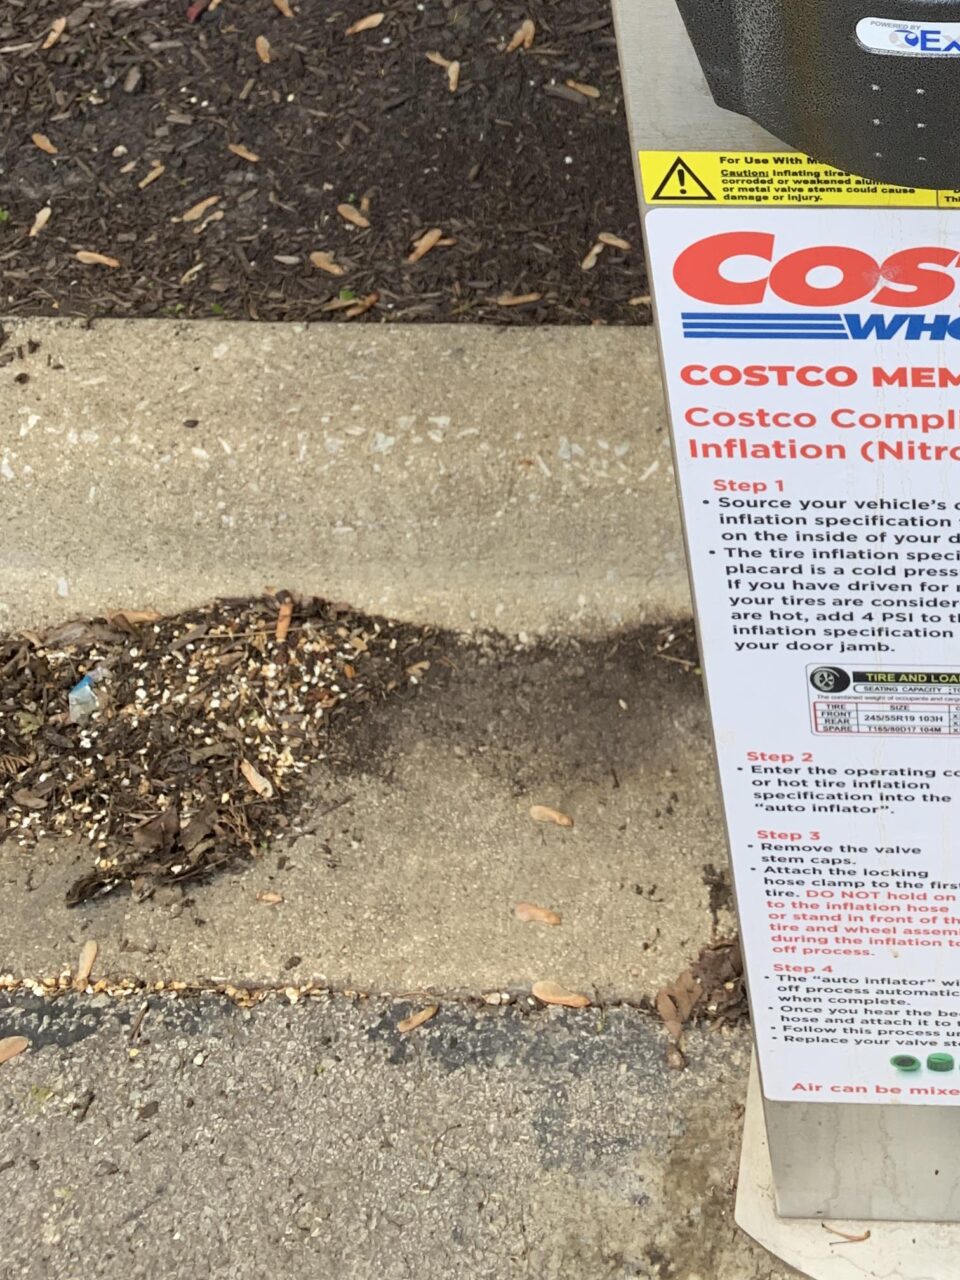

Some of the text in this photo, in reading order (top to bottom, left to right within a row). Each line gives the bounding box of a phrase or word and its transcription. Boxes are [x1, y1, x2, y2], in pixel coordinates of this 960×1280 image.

[870, 21, 908, 29] POWERED
[773, 157, 802, 165] With
[721, 170, 769, 178] Caution:
[680, 364, 858, 388] COSTCO
[684, 406, 817, 430] Costco
[688, 438, 846, 460] Inflation
[713, 479, 784, 494] Step 1
[718, 497, 792, 509] Source
[799, 499, 847, 510] your
[855, 499, 946, 510] vehicle's
[719, 514, 807, 525] inflation
[815, 515, 951, 527] specification
[721, 532, 747, 542] on
[754, 531, 788, 542] the
[796, 531, 858, 542] inside
[866, 532, 887, 543] of
[894, 534, 940, 545] your
[724, 547, 762, 558] The
[769, 548, 805, 559] tire
[812, 549, 899, 560] inflation
[725, 564, 803, 575] placard
[811, 565, 826, 575] is
[833, 566, 844, 575] a
[852, 566, 896, 576] cold
[733, 625, 816, 636] inflation
[823, 626, 953, 638] specification
[734, 640, 895, 653] your door jamb.
[866, 673, 895, 682] TIRE
[899, 674, 927, 682] AND
[747, 751, 813, 763] Step 2
[751, 765, 801, 775] Enter
[807, 766, 837, 775] the
[844, 767, 936, 778] operating
[752, 778, 930, 790] or hot tire inflation
[753, 791, 952, 803] specification into the
[757, 830, 820, 841] Step 3
[761, 843, 921, 854] Remove the valve
[761, 855, 856, 866] stem caps.
[764, 866, 929, 879] Attach the locking
[764, 877, 805, 886] hose
[812, 879, 865, 888] clamp
[872, 880, 889, 889] to
[896, 880, 924, 889] the
[773, 963, 833, 974] Step 4
[776, 974, 807, 983] The
[778, 995, 911, 1006] when complete.
[792, 1083, 823, 1092] Air
[830, 1085, 868, 1093] can
[876, 1085, 902, 1094] be
